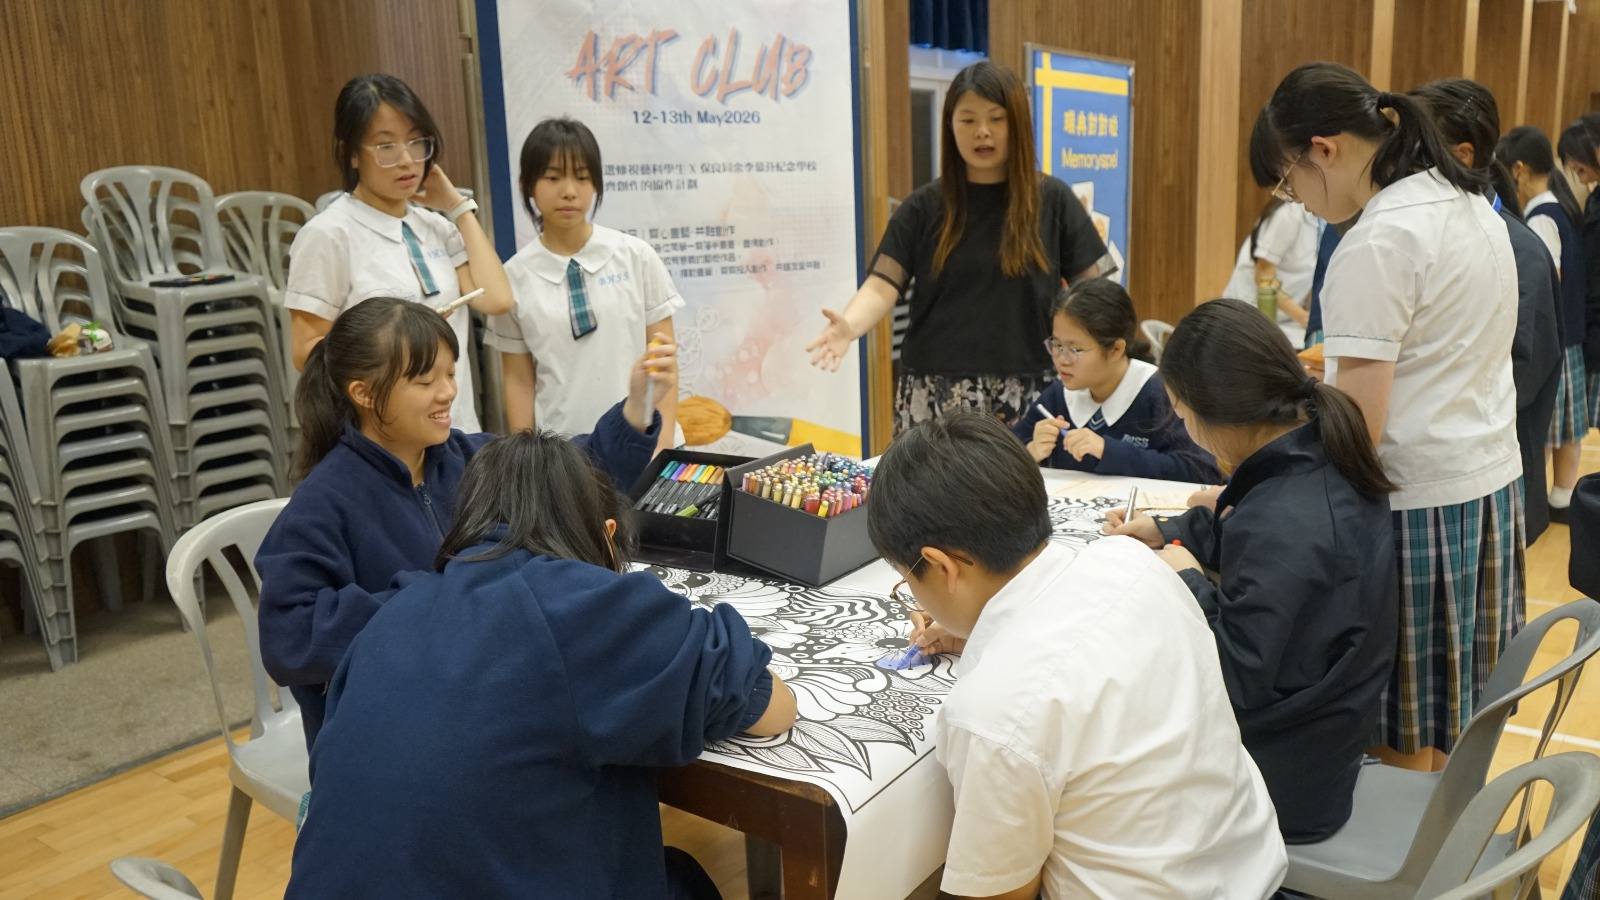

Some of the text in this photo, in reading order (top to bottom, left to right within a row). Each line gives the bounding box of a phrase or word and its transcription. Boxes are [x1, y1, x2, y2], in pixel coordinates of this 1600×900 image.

[564, 26, 813, 104] ART CLUB
[632, 110, 761, 127] 12-13th May2026
